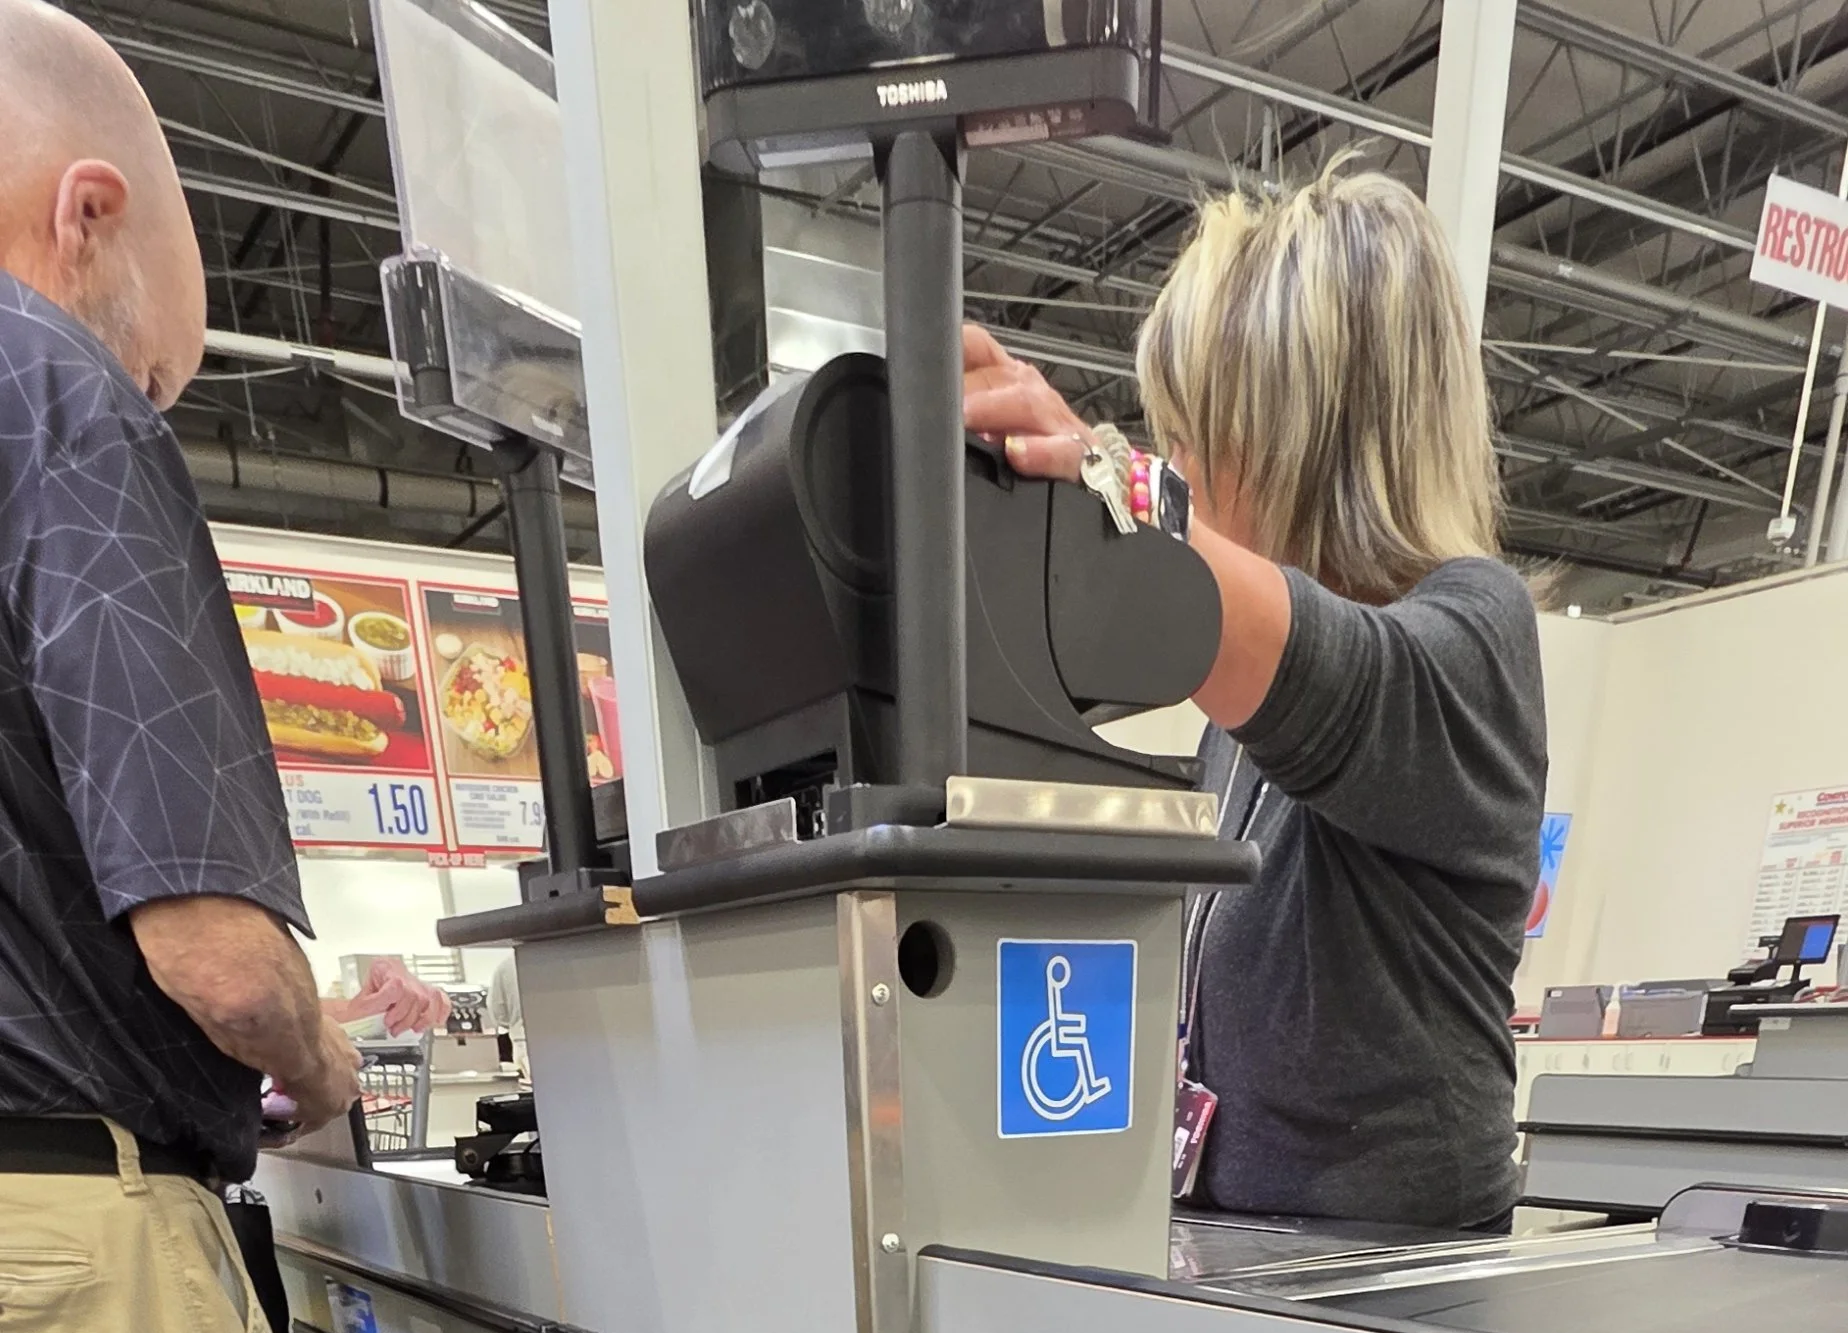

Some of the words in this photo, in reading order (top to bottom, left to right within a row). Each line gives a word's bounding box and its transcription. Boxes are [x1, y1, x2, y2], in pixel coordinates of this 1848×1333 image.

[876, 79, 948, 107] TOSHIBA
[1760, 202, 1848, 282] RESTRO
[285, 774, 304, 787] US
[368, 783, 429, 836] 1.50
[519, 801, 542, 826] 7.9
